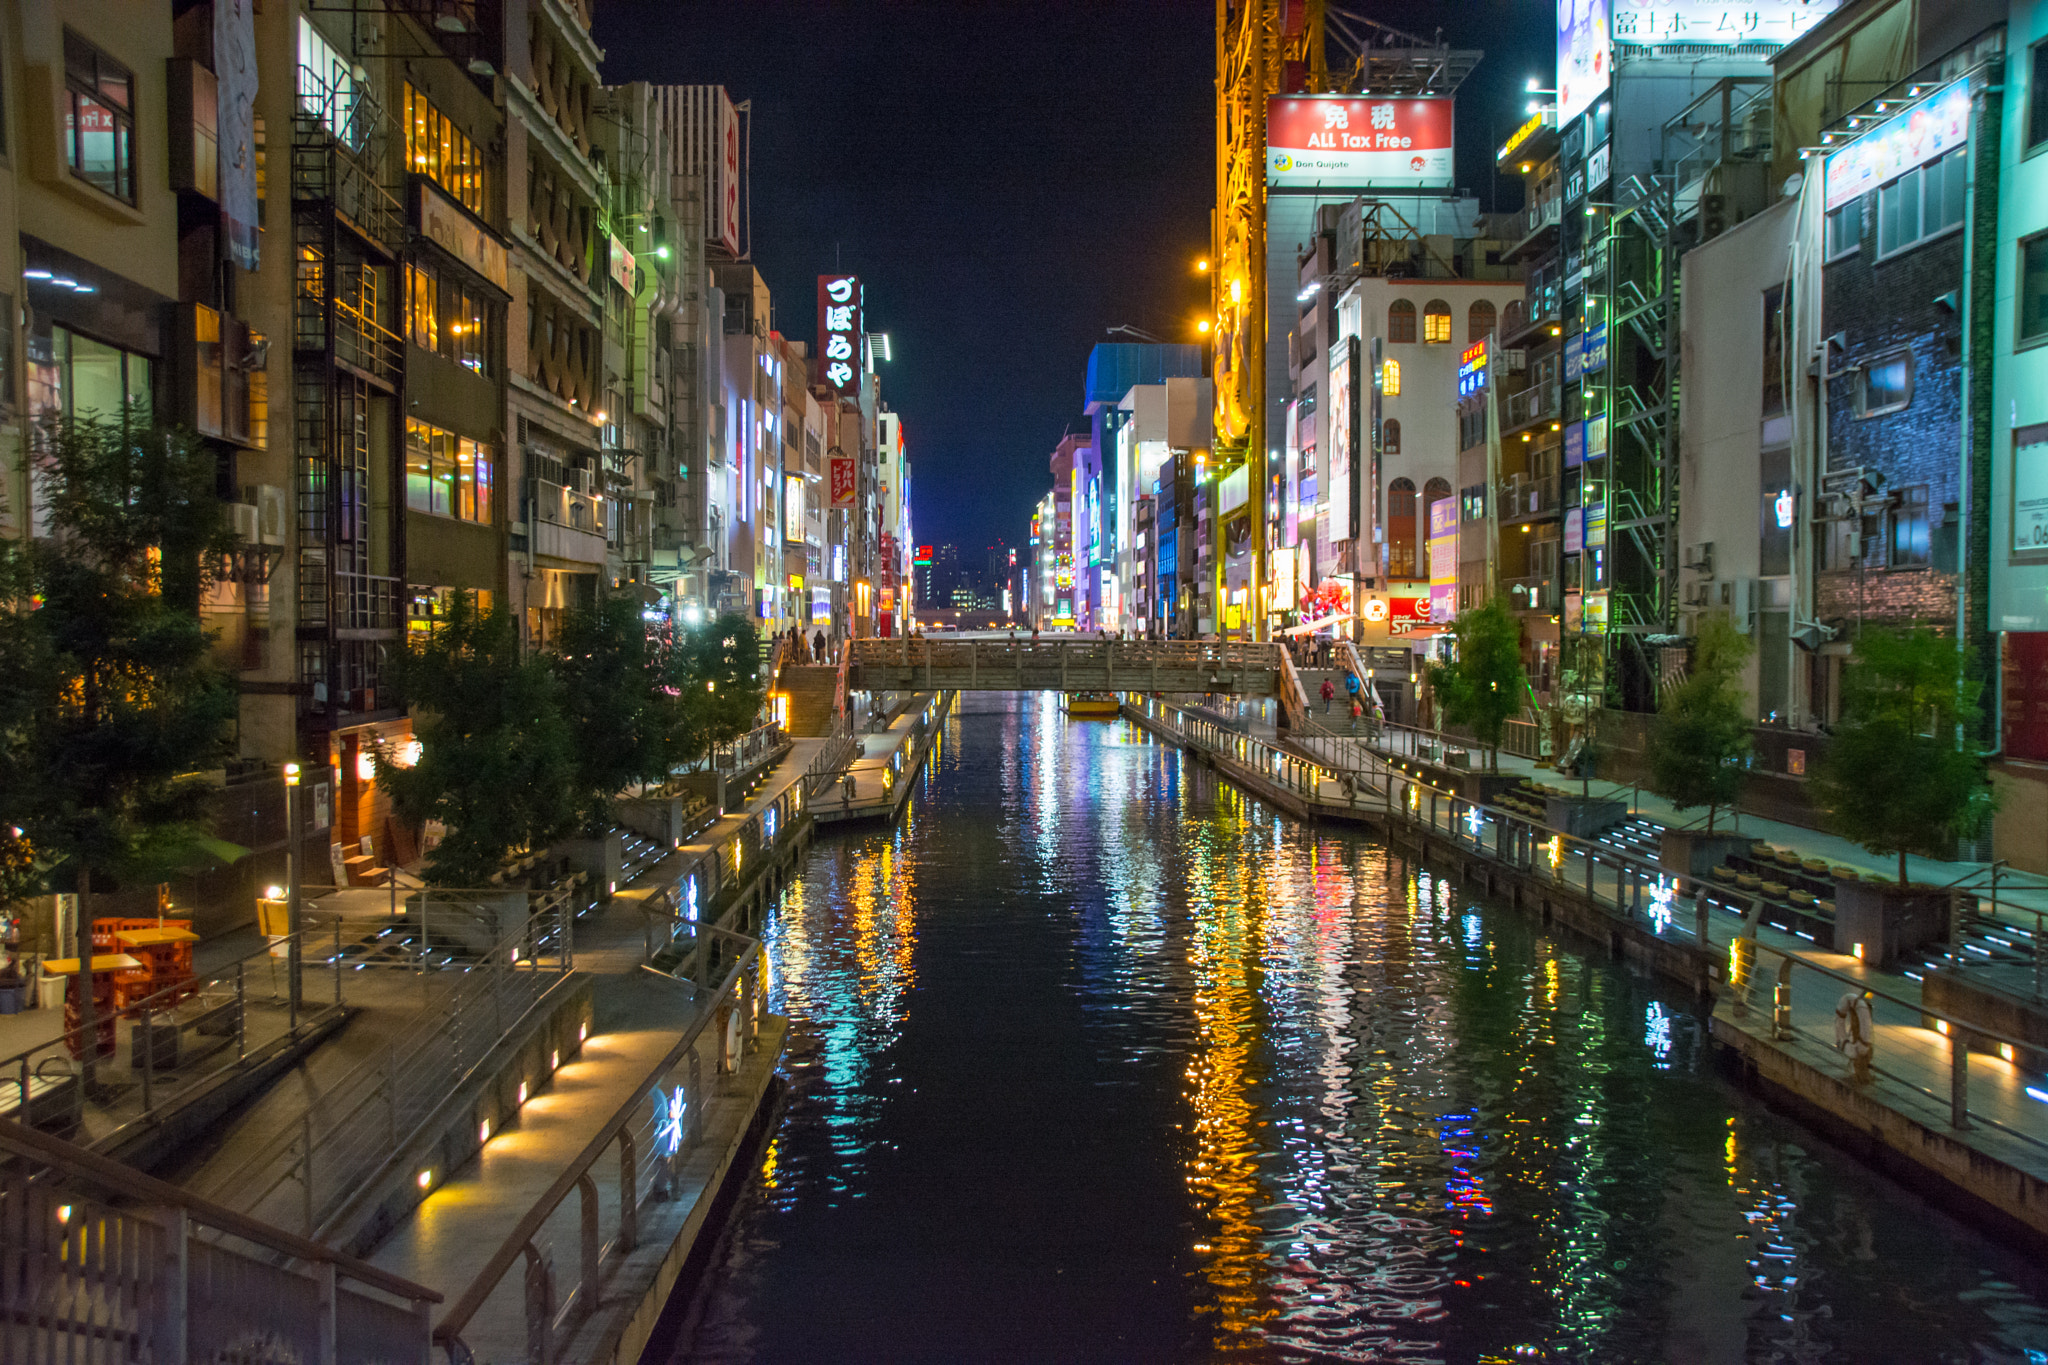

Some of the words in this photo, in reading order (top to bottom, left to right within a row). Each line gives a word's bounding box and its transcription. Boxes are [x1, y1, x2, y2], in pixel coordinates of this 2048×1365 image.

[1324, 104, 1396, 130] 免税
[1307, 133, 1336, 148] ALL
[1341, 133, 1371, 148] Tax
[1376, 134, 1412, 148] Free
[1316, 161, 1350, 170] Quijote
[827, 277, 857, 388] づぼらや
[833, 465, 842, 496] ドラッグ
[842, 460, 853, 489] ツルハ
